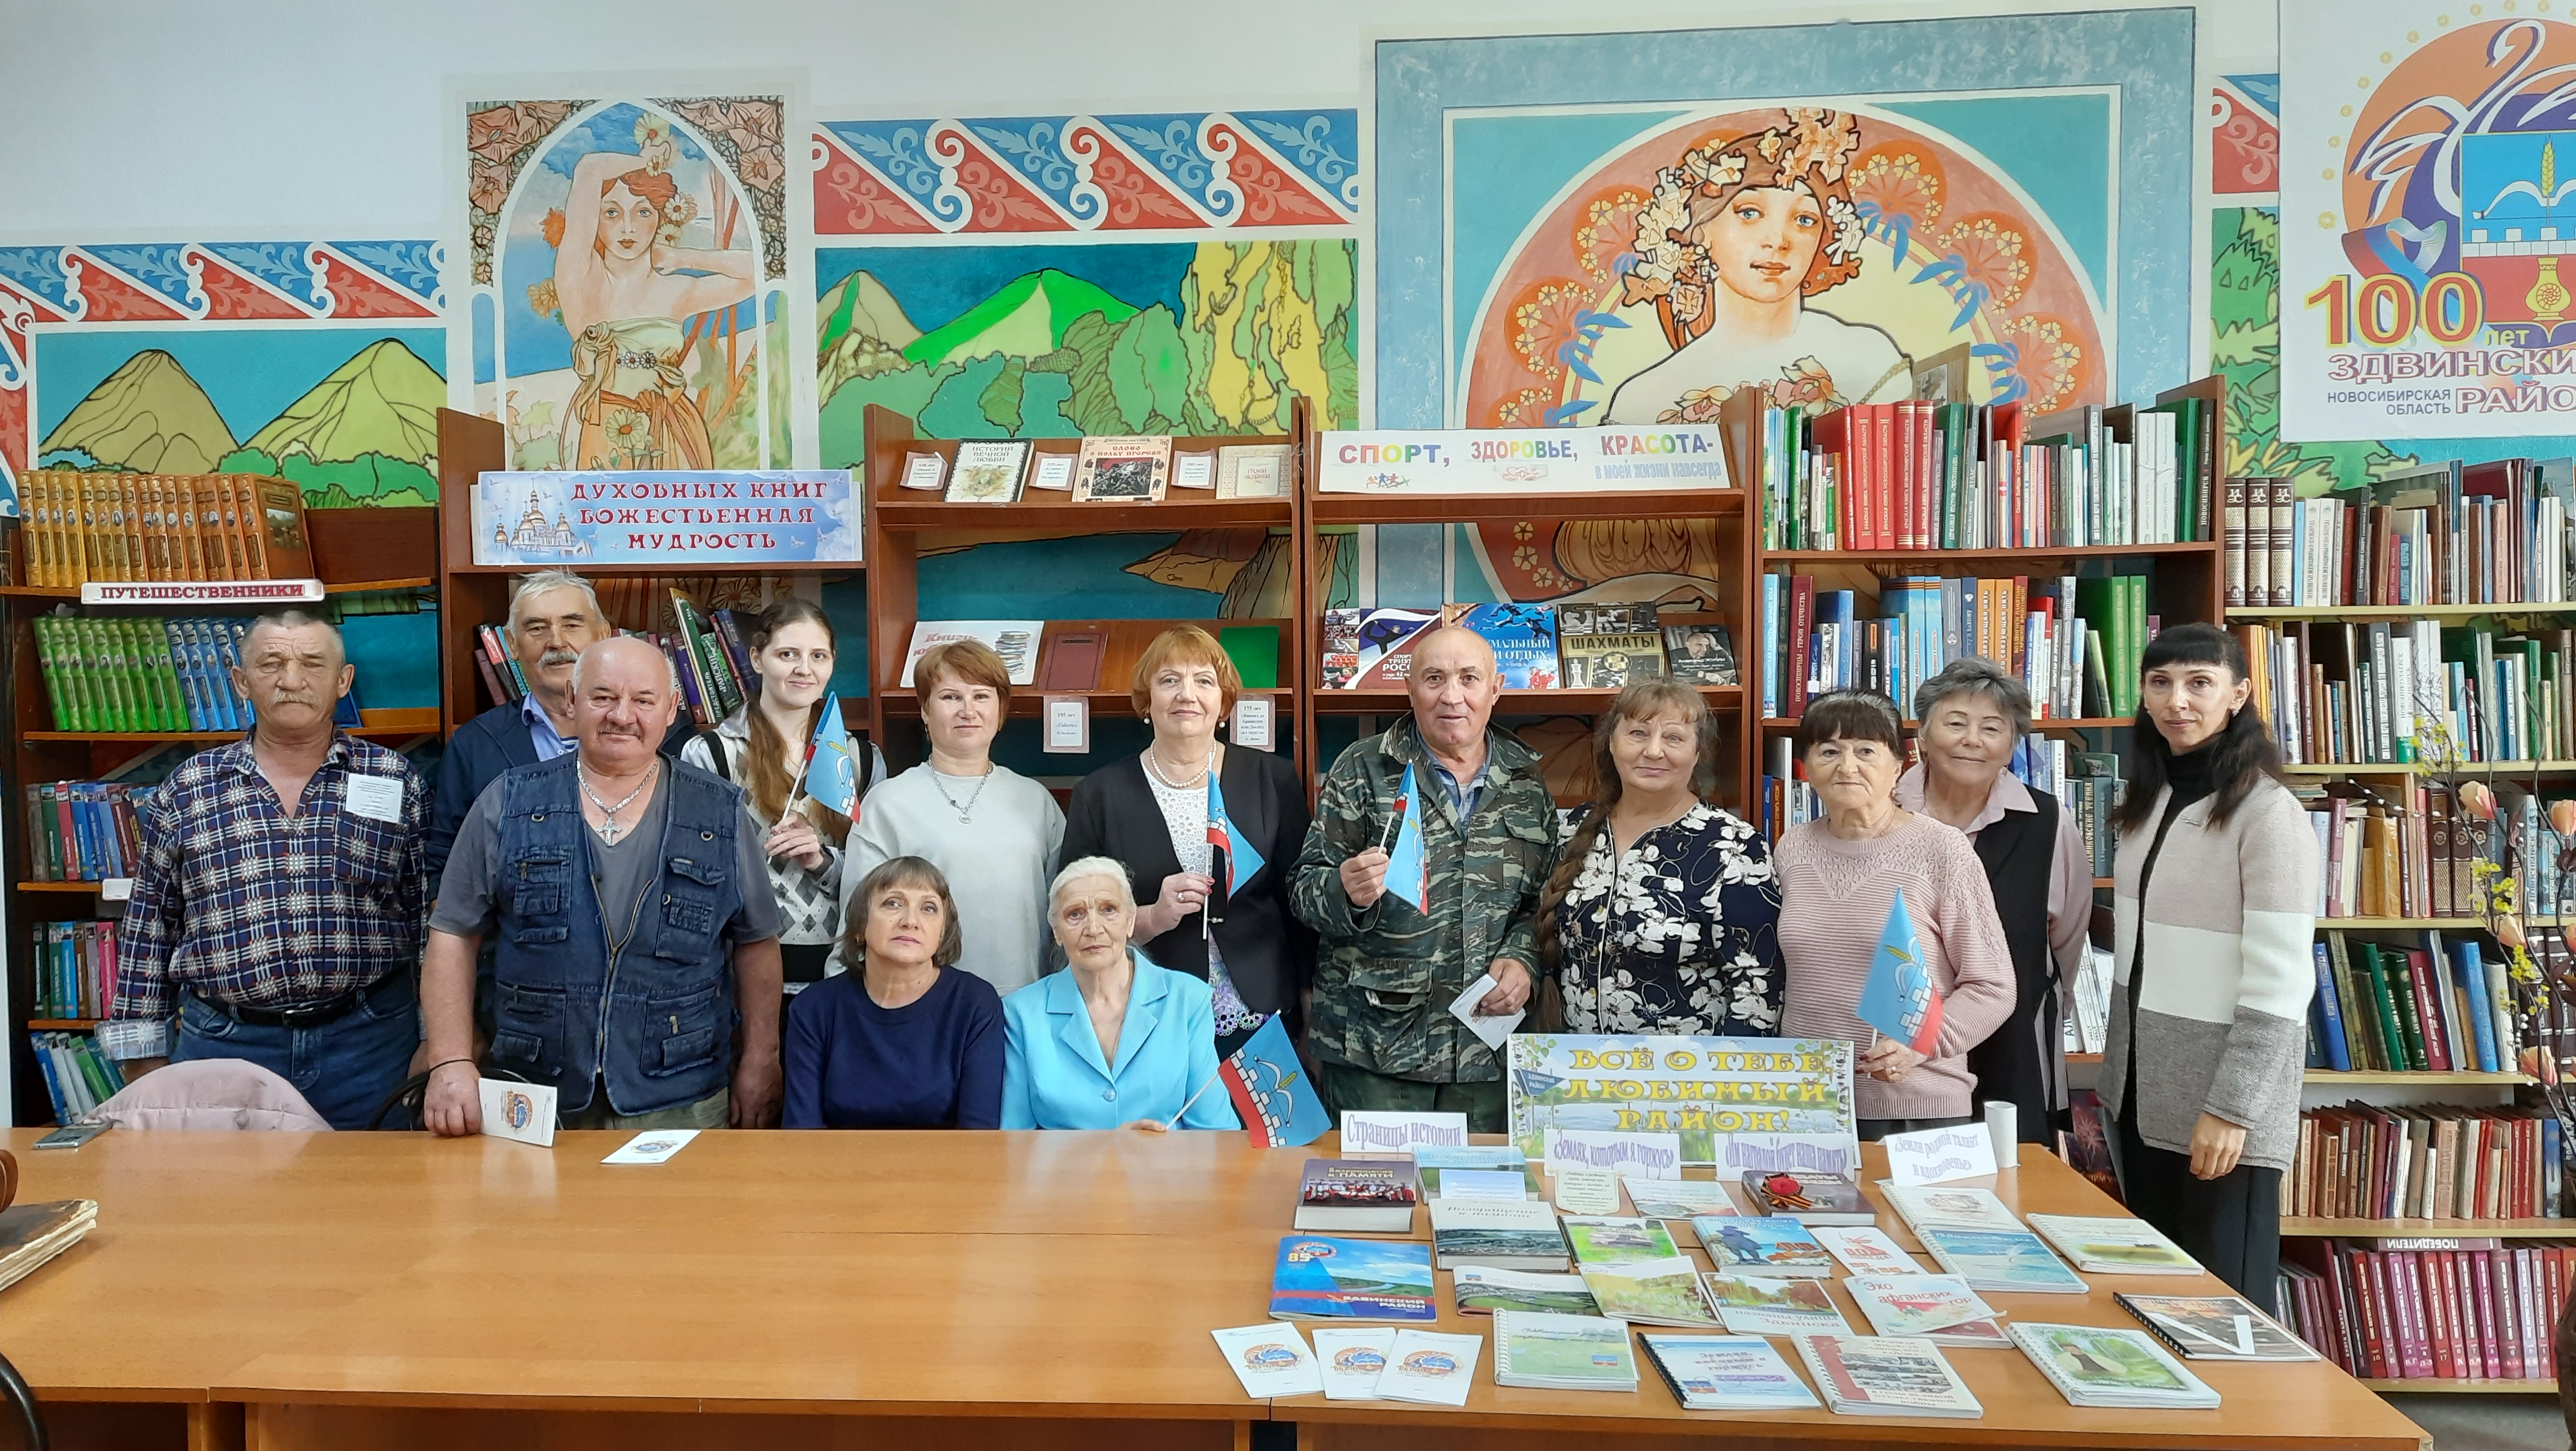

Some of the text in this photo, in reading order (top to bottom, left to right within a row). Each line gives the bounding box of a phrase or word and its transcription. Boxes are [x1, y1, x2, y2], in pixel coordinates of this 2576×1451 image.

[2304, 272, 2530, 348] 100 лет
[2327, 389, 2451, 404] НОВОСИБИРСКАЯ
[2387, 402, 2451, 415] ОБЛАСТЬ
[1338, 434, 1714, 468] СПОРТ, ЗДОРОВЬЕ, КРАСОТА-
[1594, 459, 1721, 479] в моей жизни навсегда
[570, 481, 828, 502] ДУХОВНЫХ КНИГ
[2201, 475, 2209, 525] НОВОСИБИРСК
[577, 507, 816, 525] БОЖЕСТВЕННАЯ
[627, 533, 776, 551] МУДРОСТЬ
[101, 585, 304, 599] ПУТЕШЕСТВЕННИКИ
[1798, 592, 1806, 626] ОТЕЧЕСТВА
[1488, 636, 1550, 648] МАЛЬНЫЙ
[1571, 636, 1655, 649] ШАХМАТЫ
[704, 672, 721, 718] ПРЕДСТОЯТЕЛЬ
[2085, 782, 2094, 810] ЧТЕНИЯ
[1569, 1047, 1833, 1082] ВСЁ О ТЕБЕ,
[1563, 1077, 1829, 1103] ЛЮБИМЫЙ
[1613, 1105, 1790, 1132] РАЙОН!
[1347, 1114, 1461, 1152] Страницы истории
[1554, 1129, 1589, 1169] «Земляк,
[1590, 1140, 1629, 1170] которым
[1630, 1142, 1636, 1162] я
[1924, 1129, 1953, 1158] родной
[1952, 1134, 1979, 1148] талант
[1796, 1142, 1817, 1170] наша
[2387, 1239, 2458, 1249] ПОБЕДИТЕЛИ
[1287, 1252, 1311, 1262] 85
[1863, 1282, 1893, 1291] Эхо
[1877, 1291, 1953, 1303] афганских
[1949, 1297, 1971, 1306] гор
[1735, 1310, 1792, 1319] названы
[1760, 1317, 1840, 1327] Здвинска
